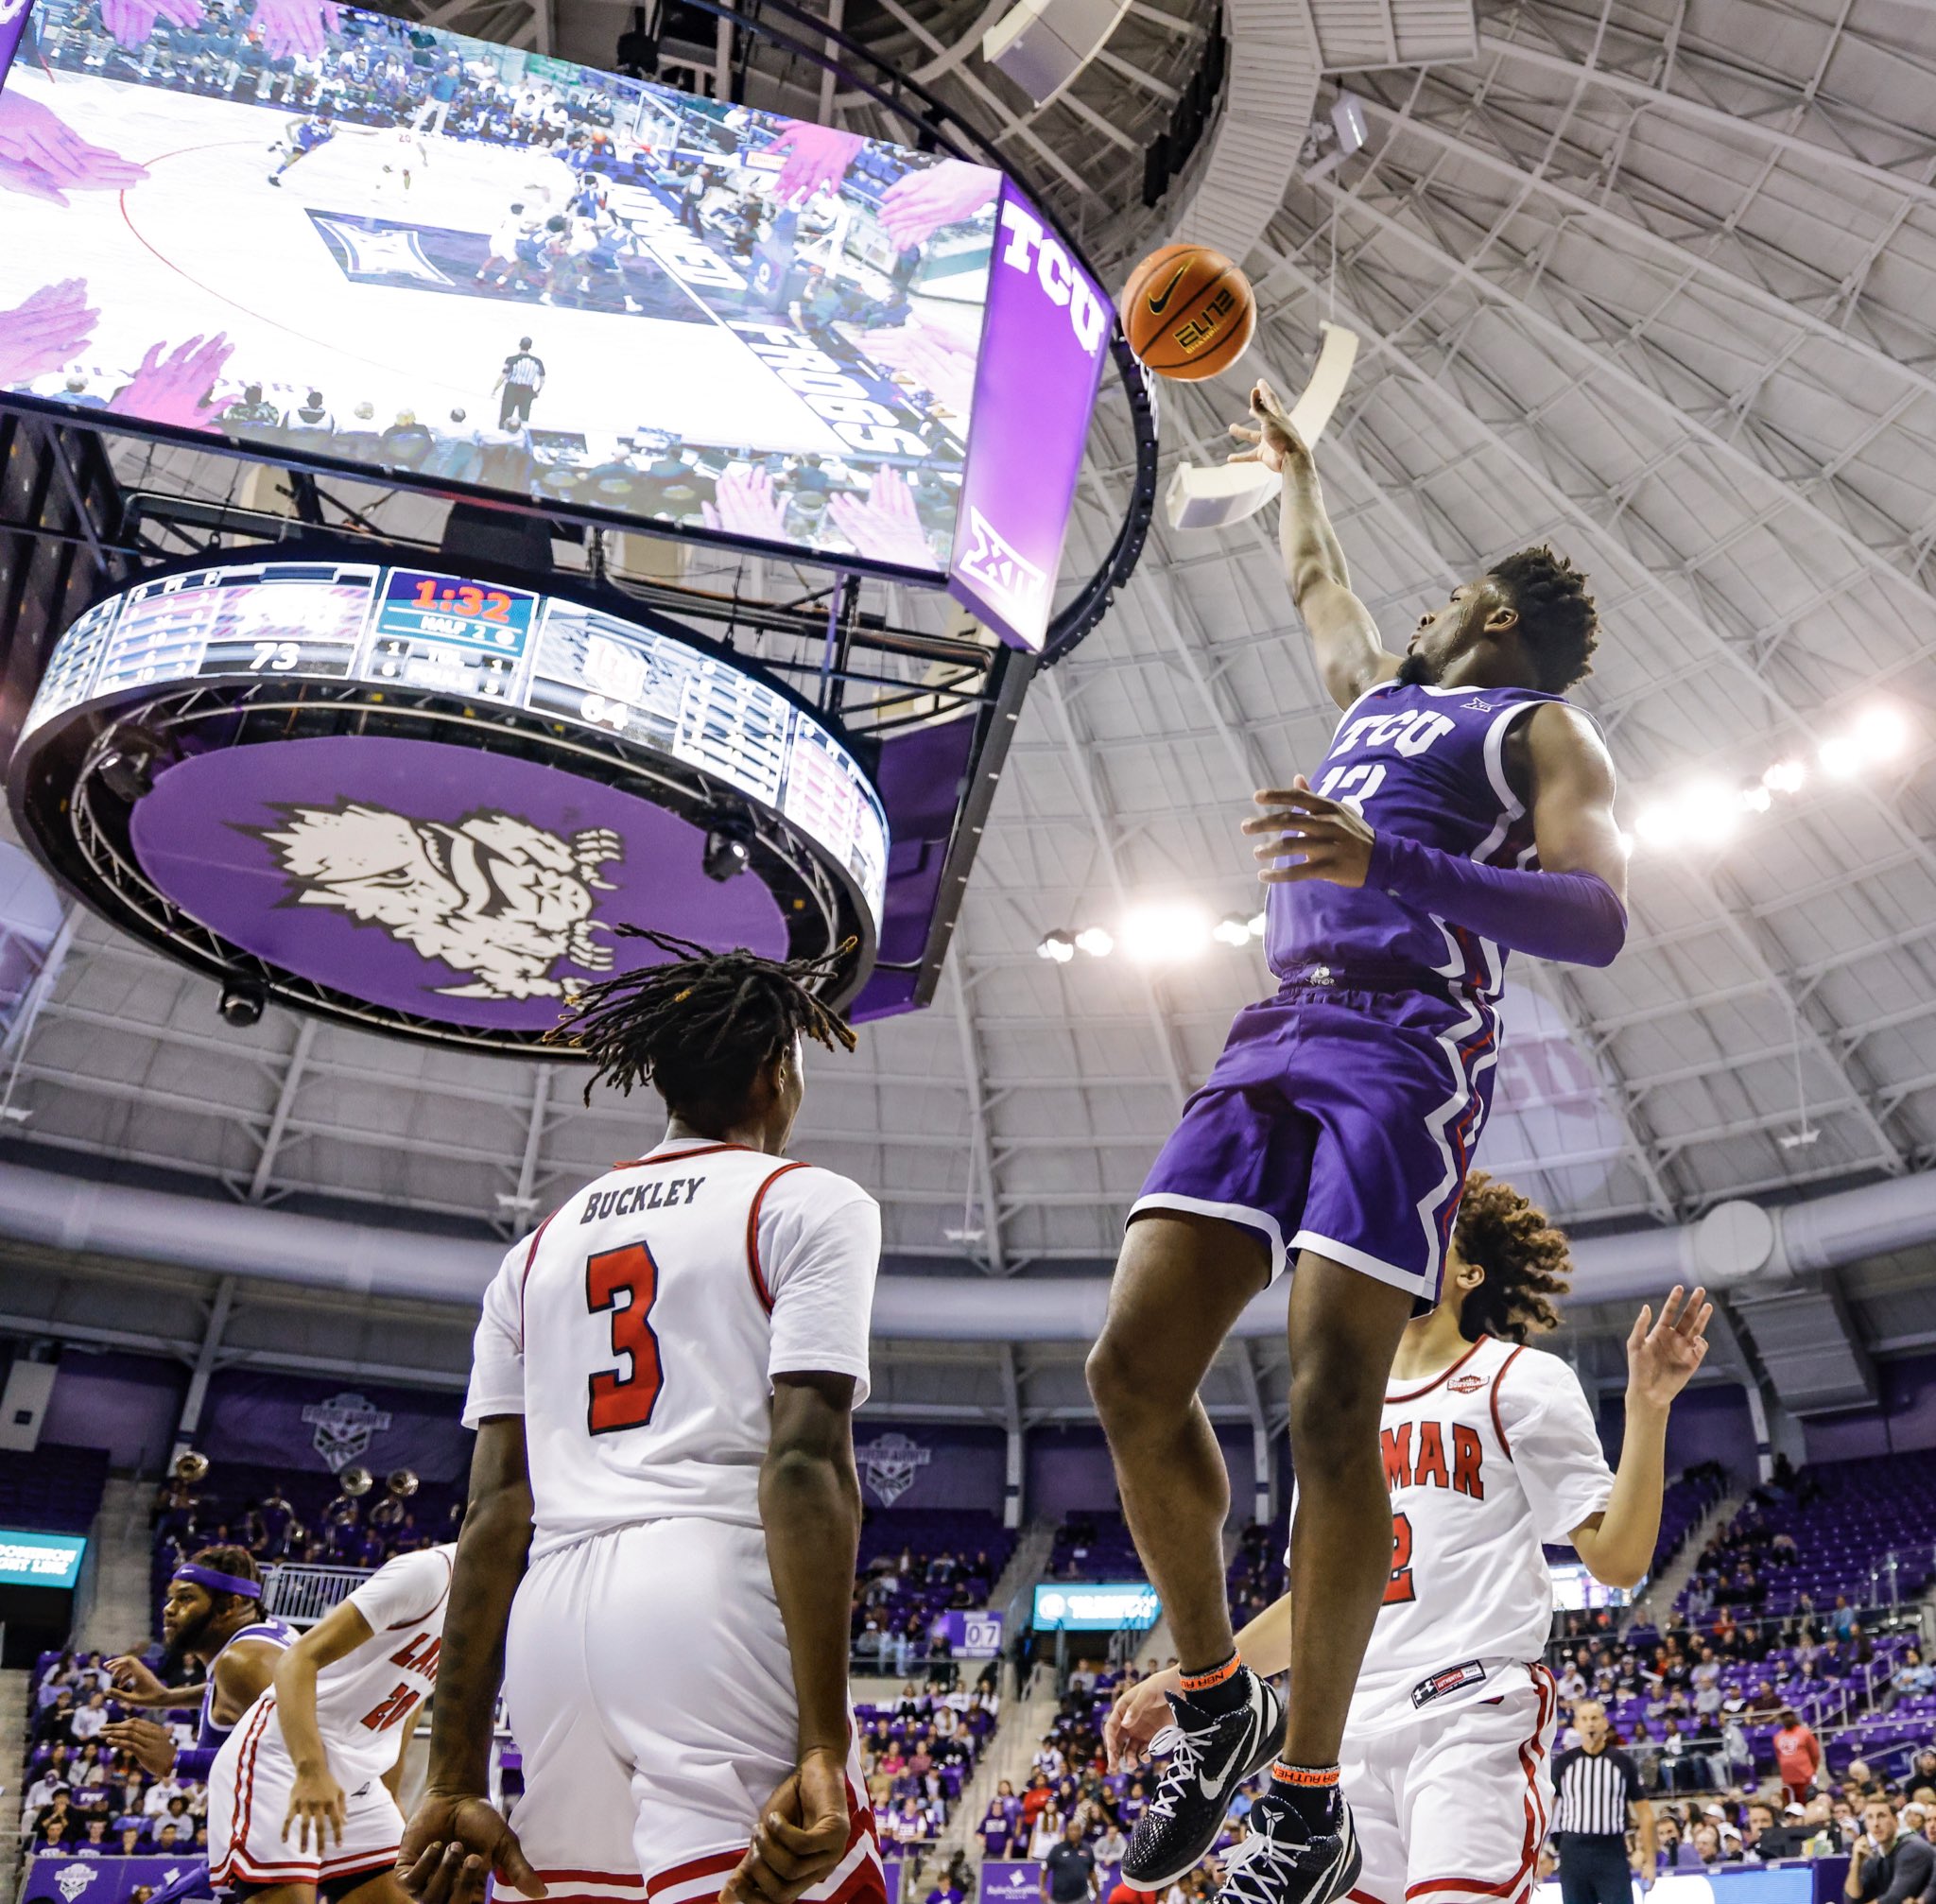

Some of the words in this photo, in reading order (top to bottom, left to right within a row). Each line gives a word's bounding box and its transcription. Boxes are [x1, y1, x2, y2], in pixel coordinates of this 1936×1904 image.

[1000, 199, 1106, 357] TCU
[412, 580, 512, 623] 1:32
[420, 615, 467, 636] HALF
[473, 625, 487, 641] 2
[249, 643, 301, 670] 73
[387, 641, 401, 656] 1
[490, 659, 504, 675] 1
[579, 694, 629, 731] 64
[1328, 709, 1457, 760] TCU
[579, 1177, 706, 1224] BUCKLEY
[585, 1239, 665, 1437] 3
[1380, 1421, 1485, 1501] MAR
[967, 1625, 997, 1645] 07
[1198, 1671, 1224, 1687] NBA
[360, 1683, 421, 1733] 20
